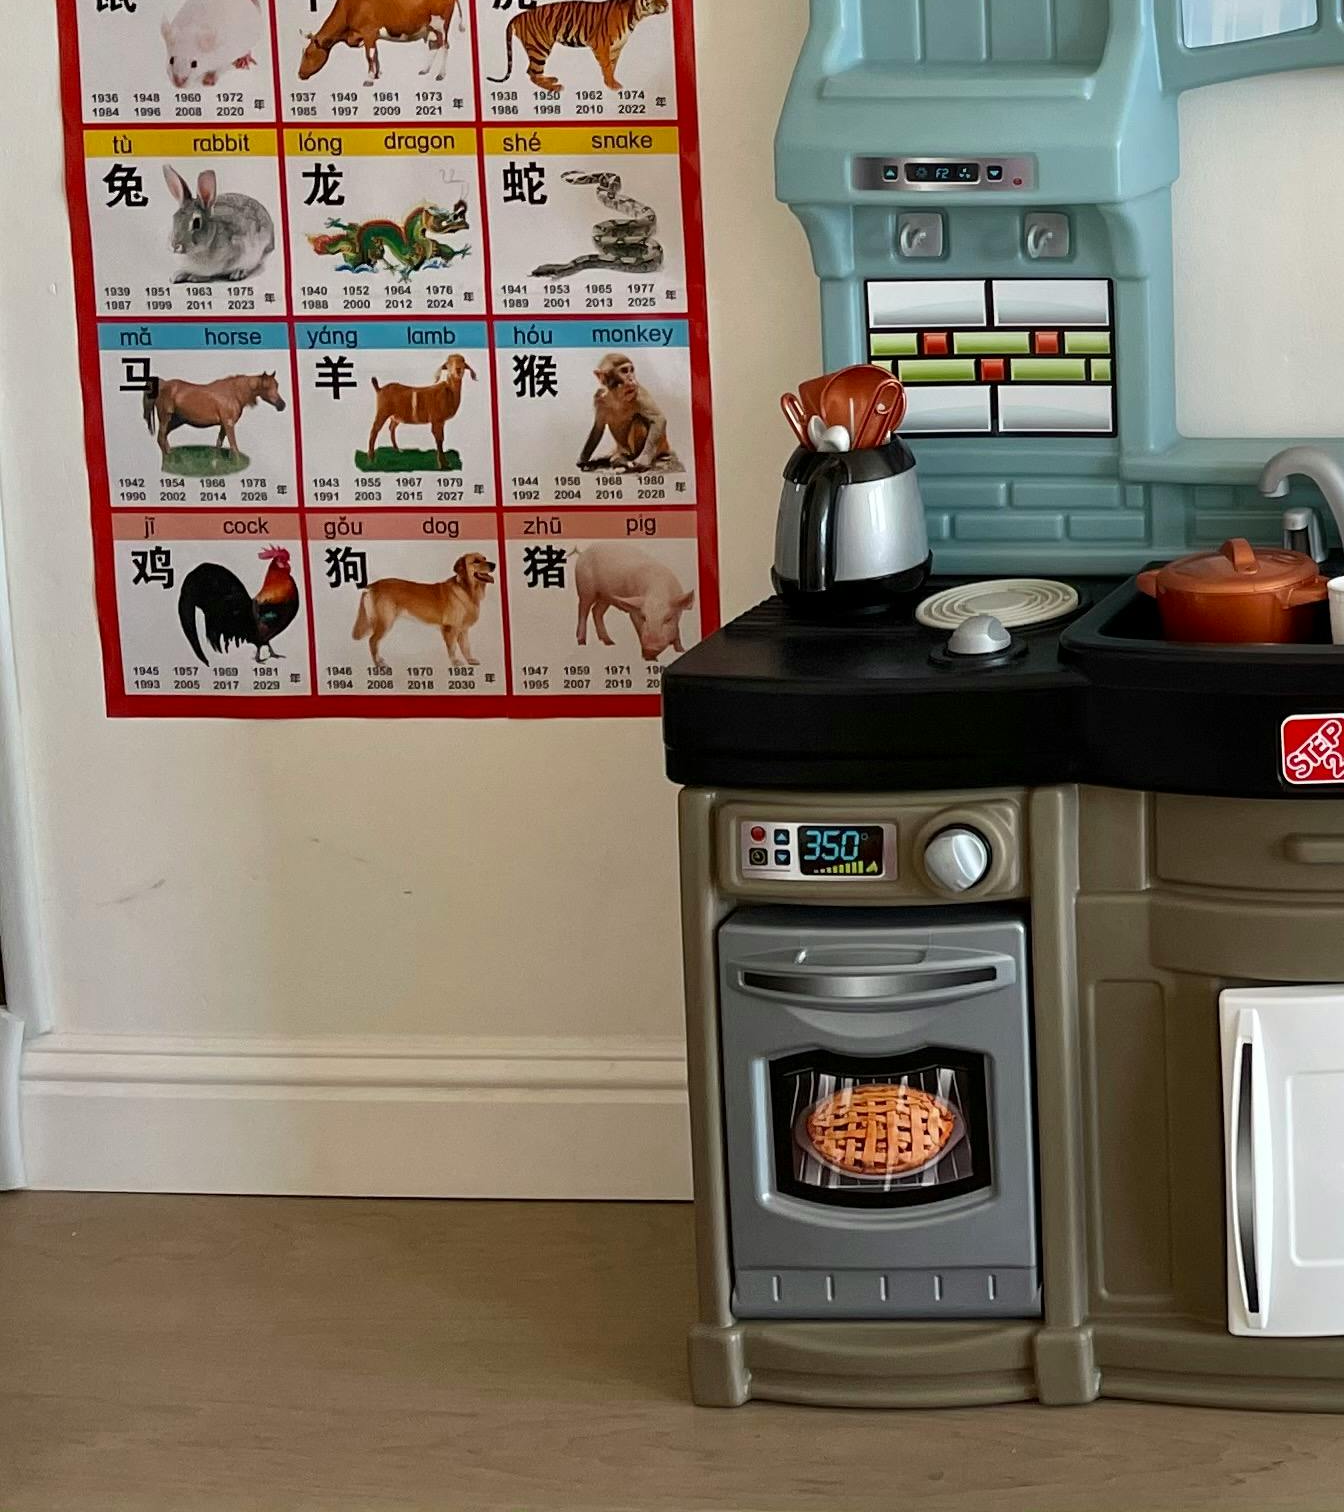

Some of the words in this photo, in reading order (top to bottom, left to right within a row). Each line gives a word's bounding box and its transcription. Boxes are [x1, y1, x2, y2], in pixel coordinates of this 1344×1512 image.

[193, 134, 250, 152] rabbit
[384, 132, 455, 154] dragon
[591, 131, 653, 150] snake
[102, 163, 149, 208] 兔
[302, 163, 345, 206] 龙
[502, 161, 548, 205] 蛇
[204, 327, 262, 345] horse
[407, 325, 456, 345] lamb
[592, 324, 673, 347] monkey
[119, 357, 160, 398] 马
[315, 355, 357, 400] 羊
[512, 354, 558, 399] 猴
[223, 517, 269, 535] cock
[422, 516, 459, 538] dog
[626, 513, 657, 536] pig
[131, 545, 174, 589] 鸡
[325, 545, 368, 590] 狗
[523, 544, 567, 589] 猪
[1287, 719, 1342, 779] STEP
